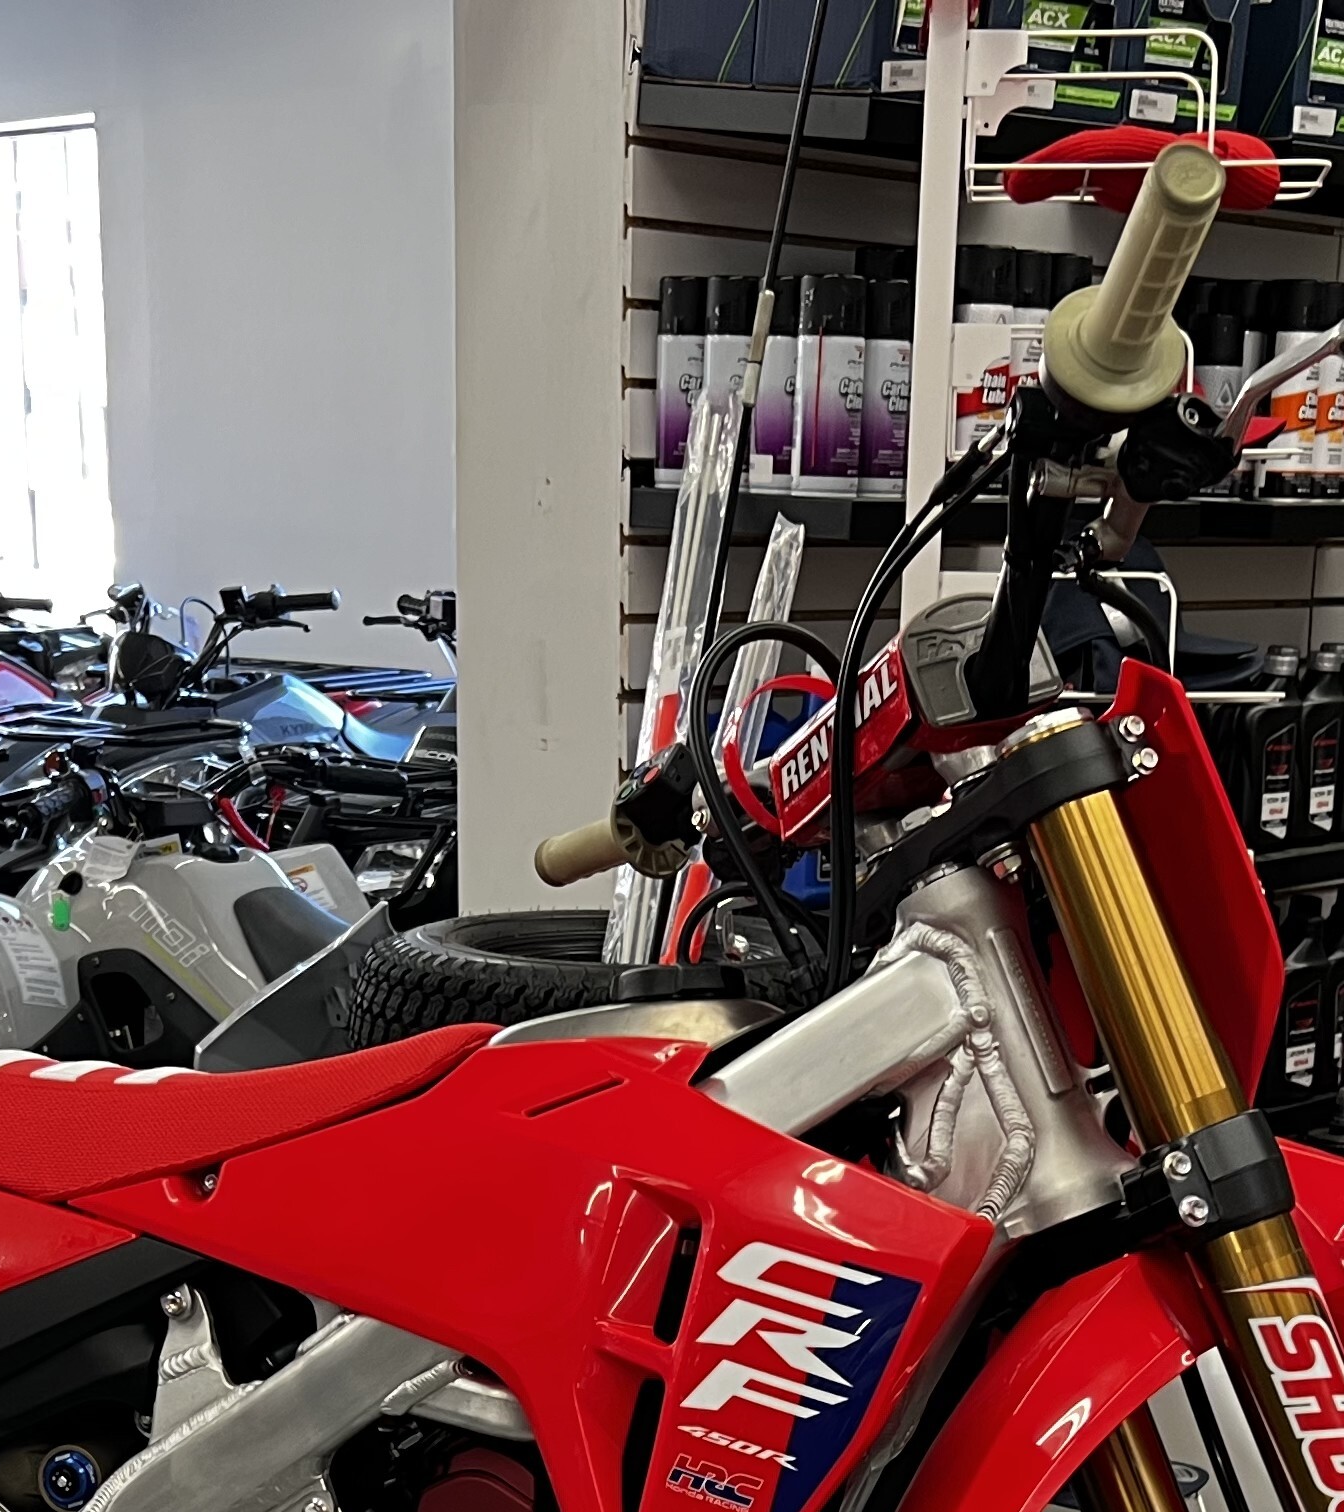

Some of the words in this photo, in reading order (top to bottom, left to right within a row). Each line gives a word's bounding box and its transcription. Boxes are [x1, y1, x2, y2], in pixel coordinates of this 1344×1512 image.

[1028, 9, 1071, 28] ACX
[982, 388, 1006, 404] Lube
[983, 372, 1006, 388] hain
[781, 659, 898, 800] RENAL
[679, 1241, 883, 1419] CRF
[677, 1425, 799, 1472] 450R
[667, 1453, 764, 1508] HRC
